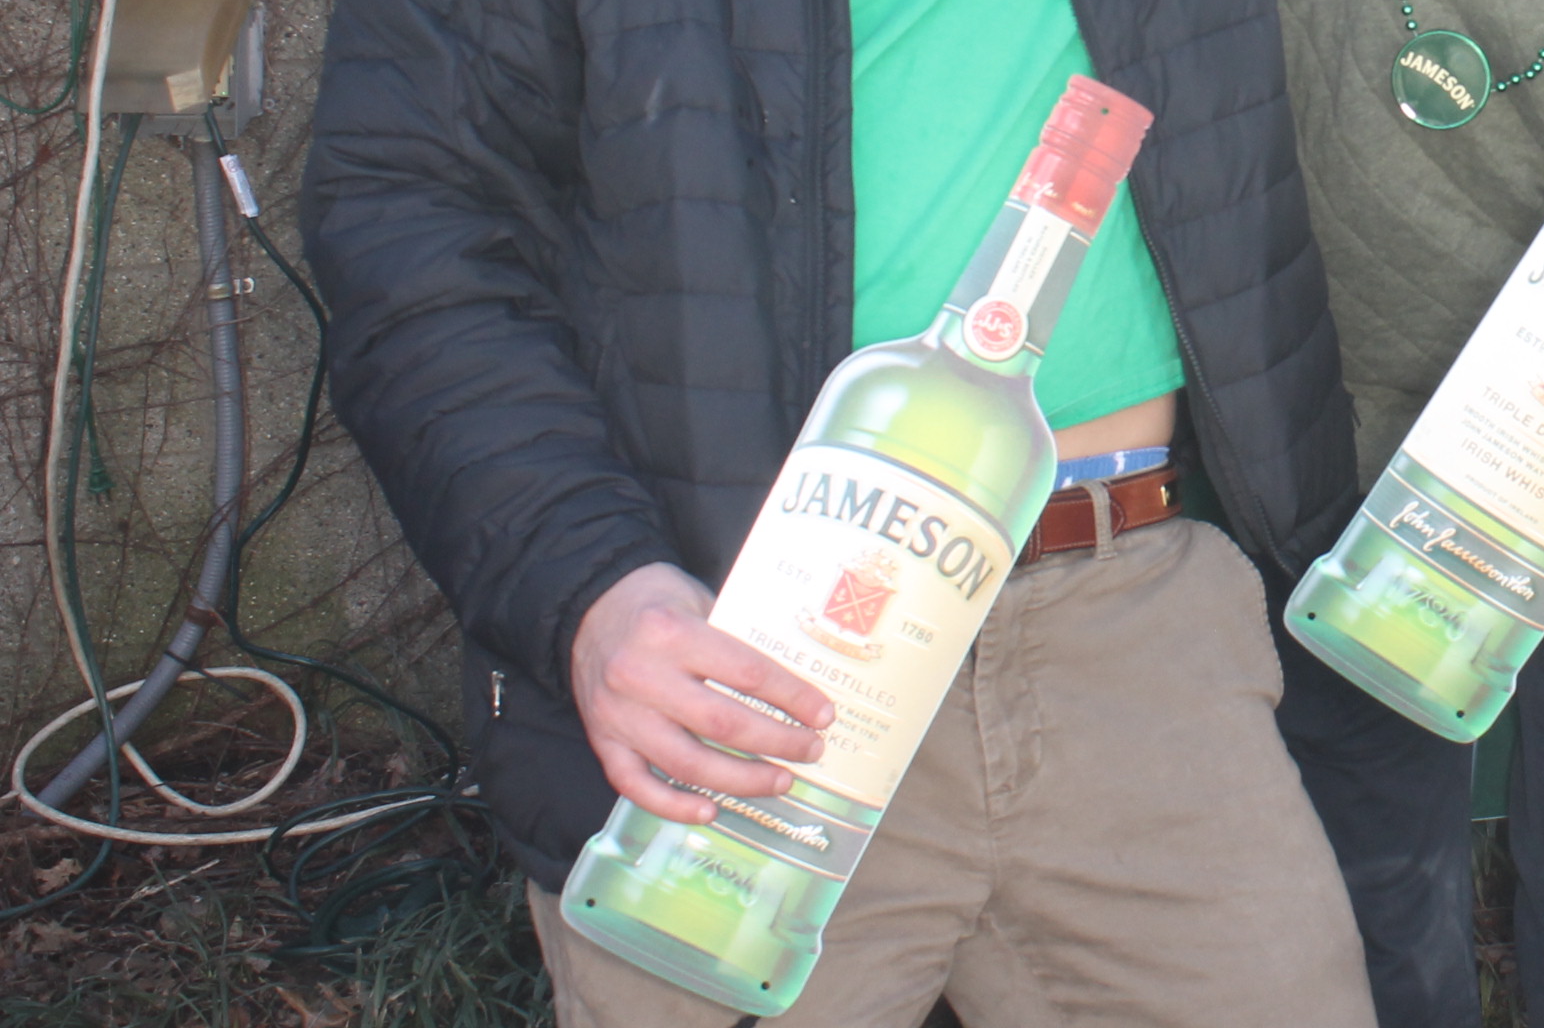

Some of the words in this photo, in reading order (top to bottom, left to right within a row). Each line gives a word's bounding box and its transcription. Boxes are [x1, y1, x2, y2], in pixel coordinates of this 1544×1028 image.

[1400, 51, 1475, 110] JAMESON
[1482, 386, 1534, 428] TRIPLE
[1460, 437, 1503, 471] IRISH
[1482, 432, 1524, 464] JAMESON
[782, 472, 995, 601] JAMESON
[900, 621, 935, 645] 1780
[748, 628, 809, 667] TRIPLE
[810, 659, 898, 708] DISTILLED
